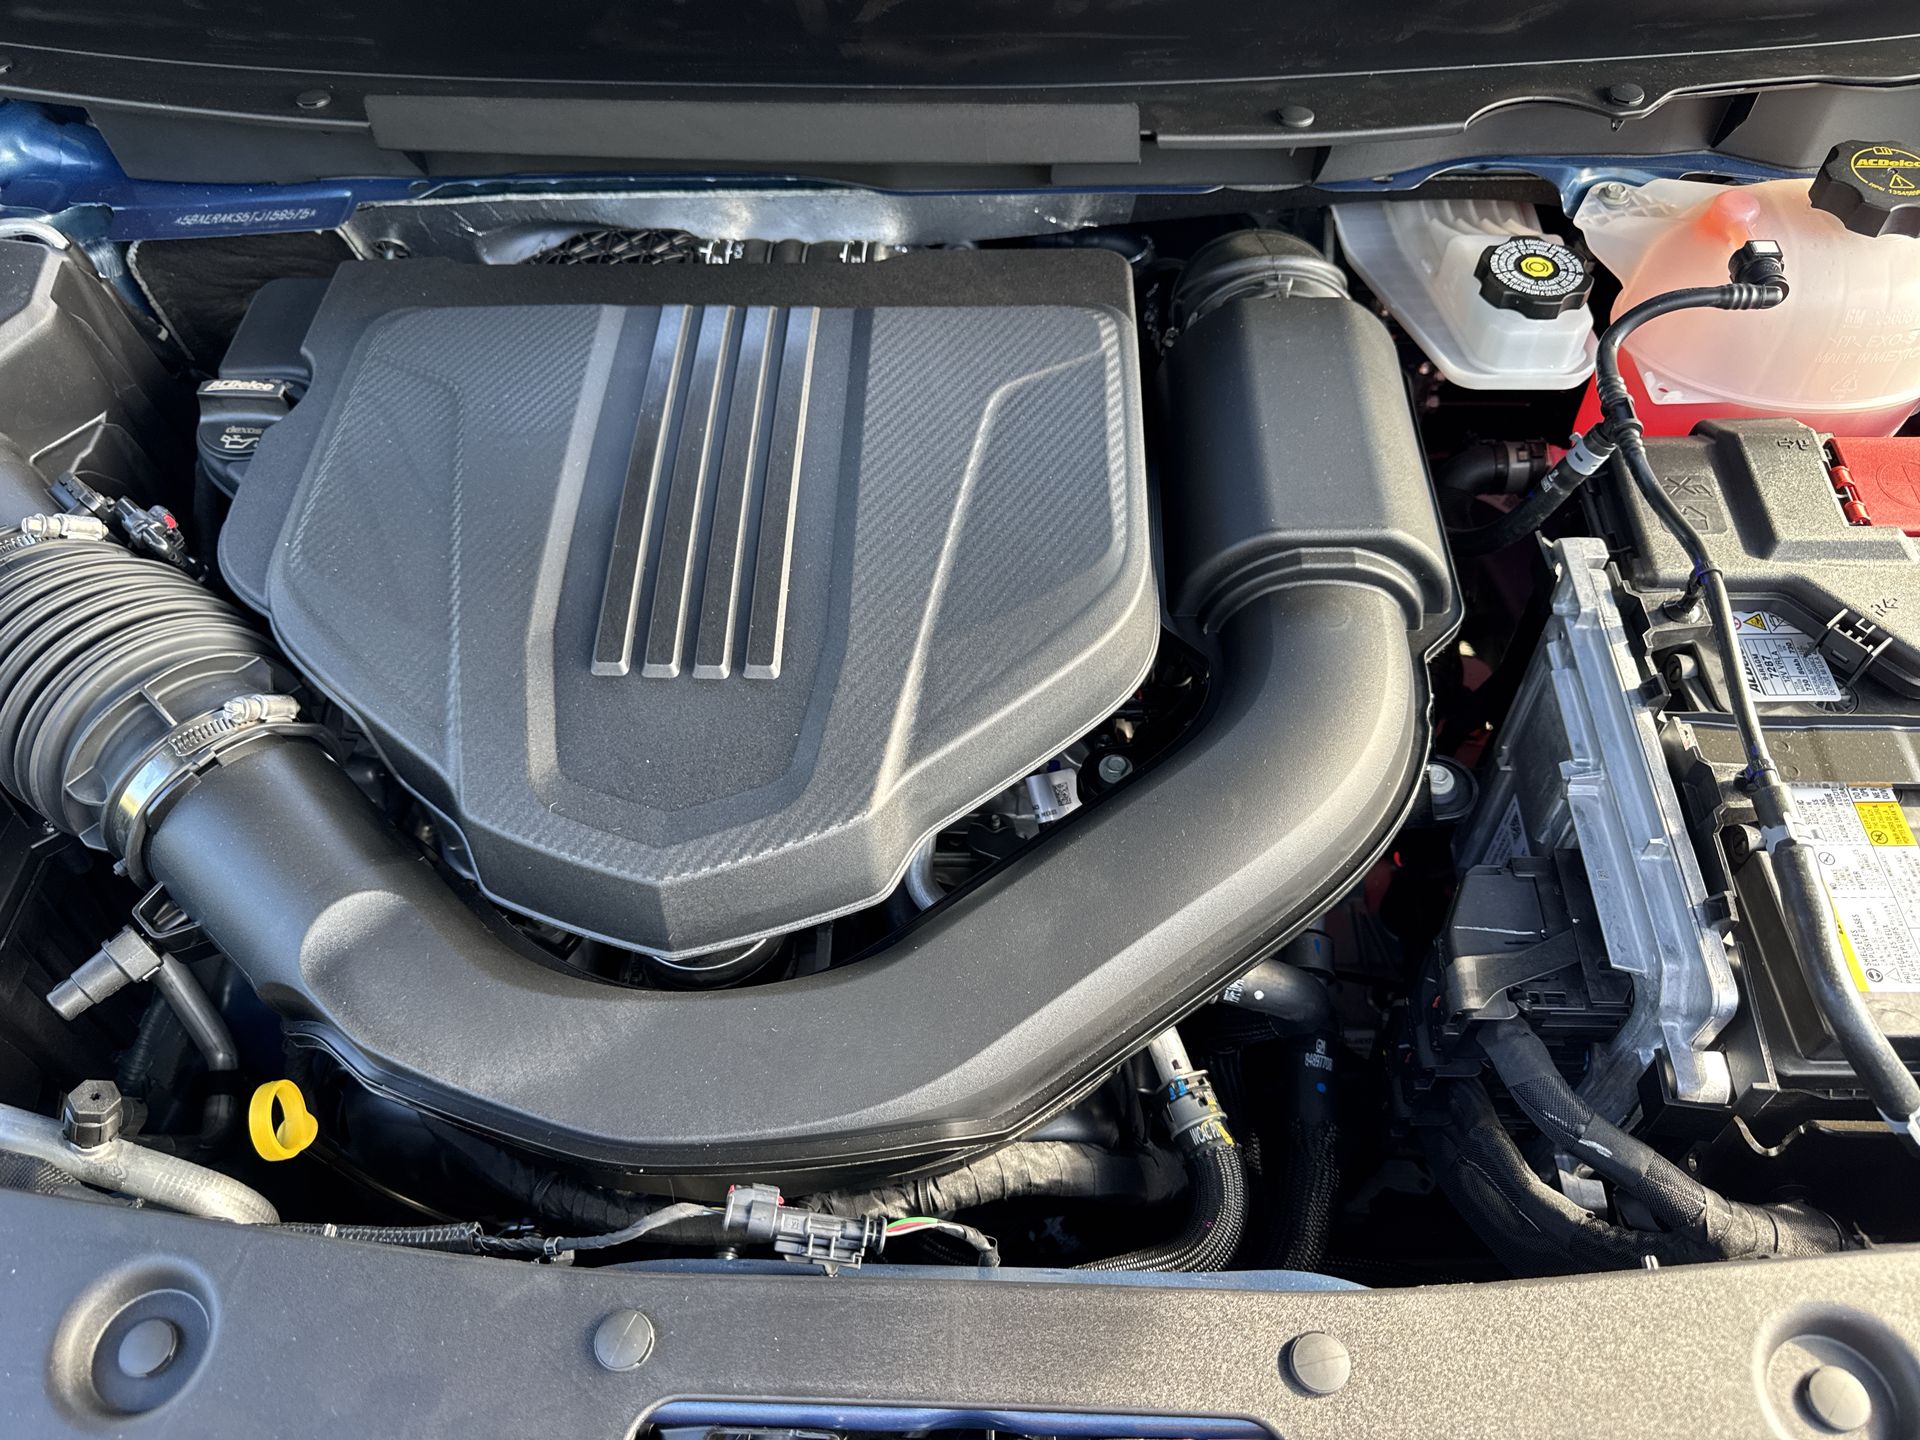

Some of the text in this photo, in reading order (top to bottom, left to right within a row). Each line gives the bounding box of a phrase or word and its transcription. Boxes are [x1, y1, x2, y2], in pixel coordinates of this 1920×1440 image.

[1786, 642, 1795, 654] 730
[1762, 655, 1779, 678] 7287
[1771, 651, 1790, 682] 12V VRLA
[1802, 679, 1812, 691] 730
